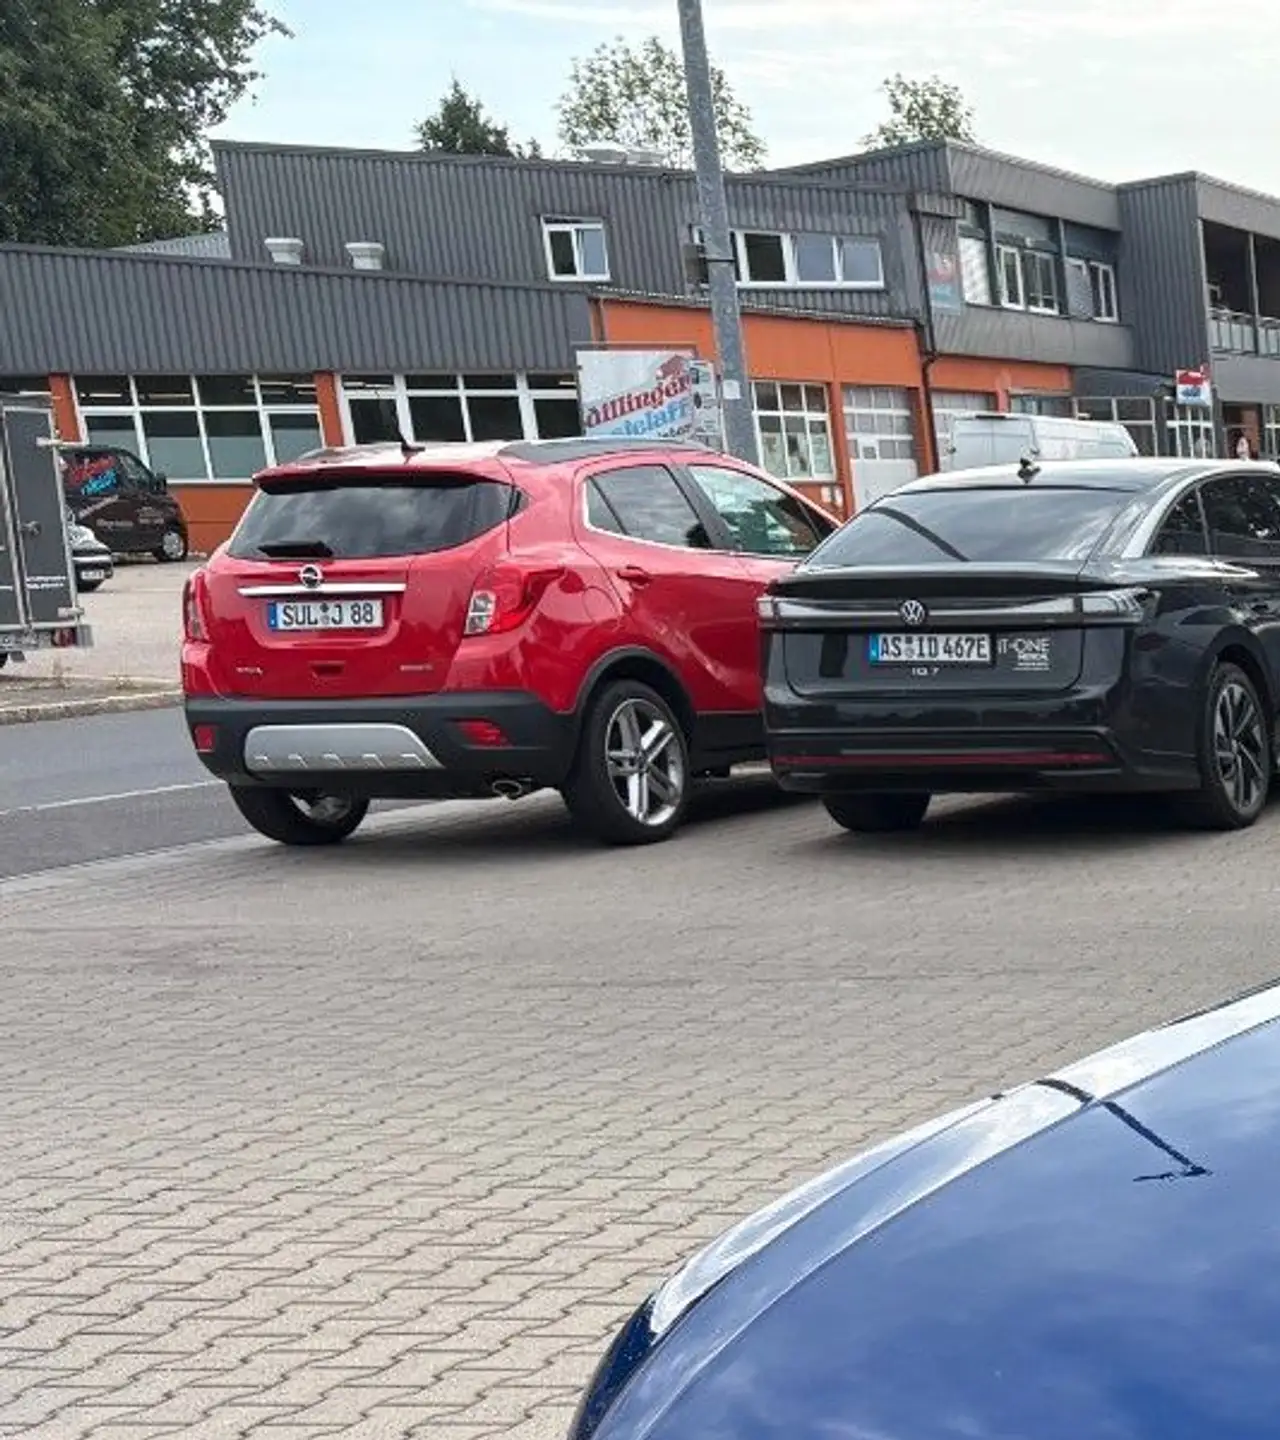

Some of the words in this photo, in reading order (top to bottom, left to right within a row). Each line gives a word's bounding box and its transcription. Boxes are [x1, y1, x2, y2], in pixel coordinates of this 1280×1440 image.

[282, 604, 318, 626] SUL
[331, 604, 343, 624] J
[350, 602, 374, 623] 88
[880, 636, 901, 659] AS
[918, 636, 939, 659] ID
[943, 636, 988, 659] 467E
[998, 638, 1050, 654] IT-ONE
